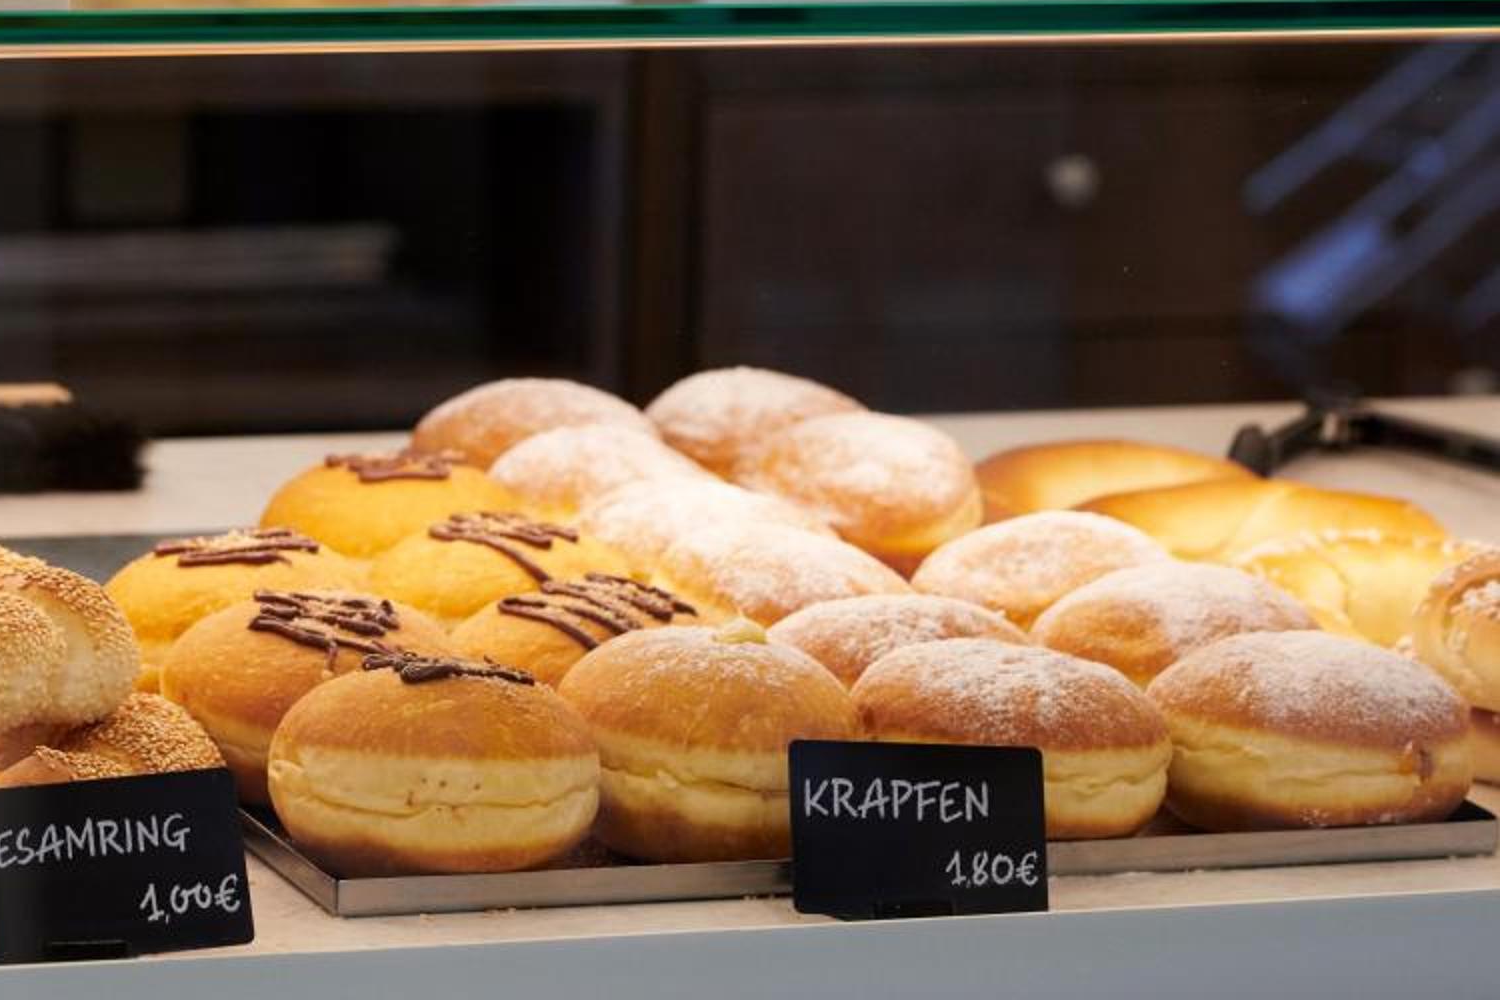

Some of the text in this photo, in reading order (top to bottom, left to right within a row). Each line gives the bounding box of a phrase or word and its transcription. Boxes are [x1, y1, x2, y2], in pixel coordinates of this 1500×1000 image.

[804, 776, 990, 823] KRAPFEN
[945, 850, 1039, 889] 1,80€
[138, 873, 241, 924] 1,00€
